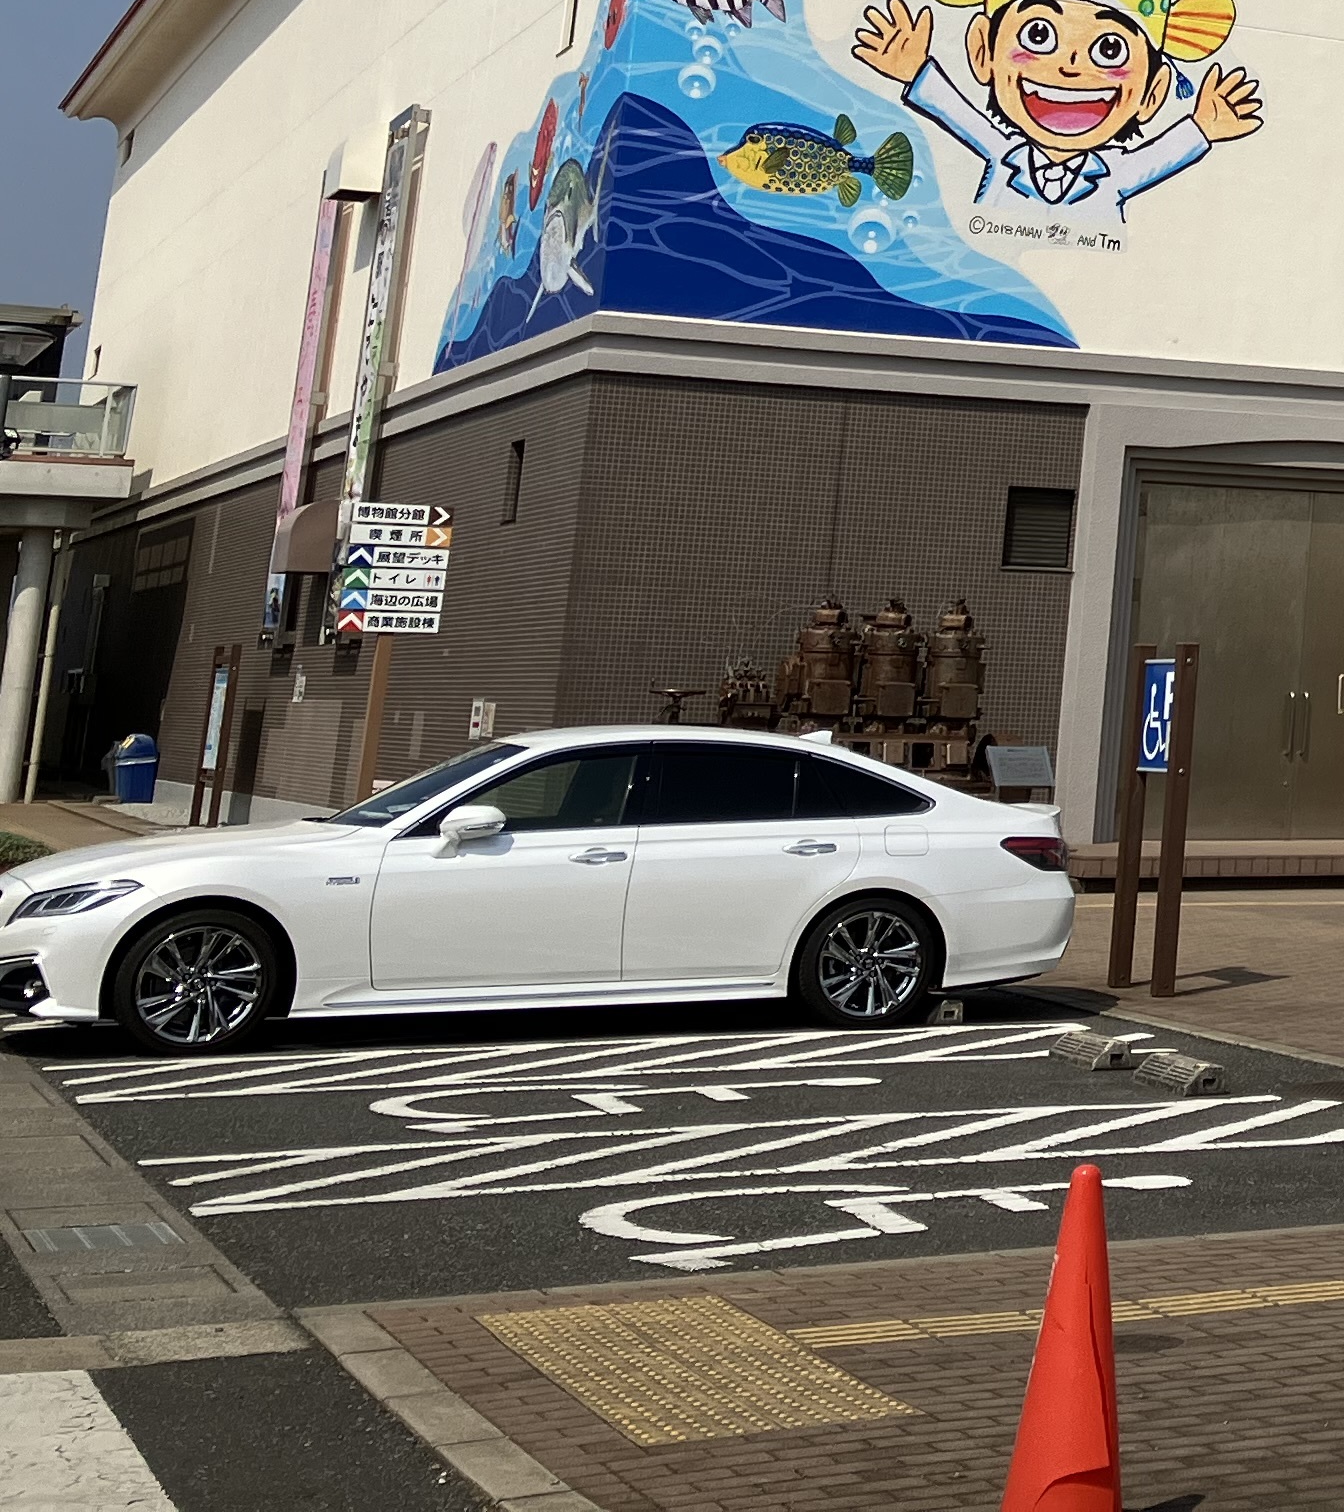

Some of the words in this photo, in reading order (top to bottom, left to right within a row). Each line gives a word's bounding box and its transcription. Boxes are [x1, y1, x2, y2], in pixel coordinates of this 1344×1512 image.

[376, 551, 444, 565] 展望デッキ
[373, 572, 417, 584] トイレ
[369, 593, 439, 608] 海辺の広場
